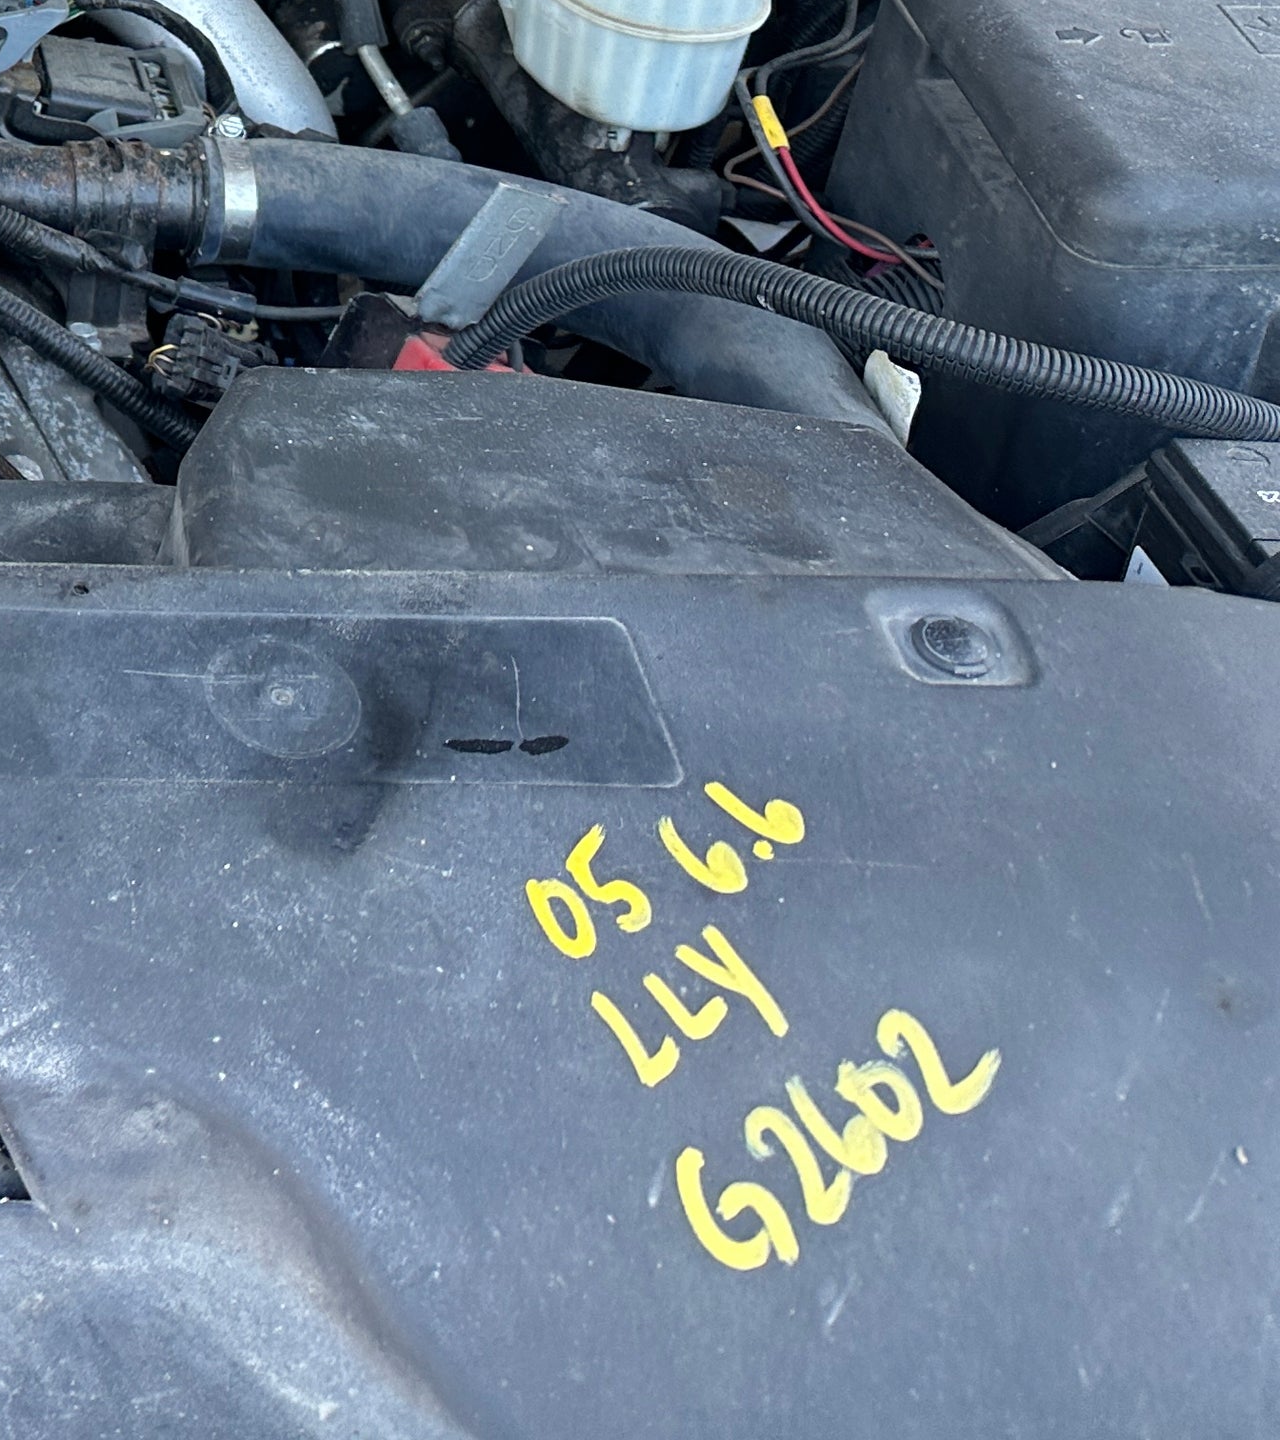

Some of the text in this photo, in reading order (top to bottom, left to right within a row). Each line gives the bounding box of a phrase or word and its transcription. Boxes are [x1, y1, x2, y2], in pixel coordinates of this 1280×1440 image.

[526, 781, 805, 959] 05 6.6
[591, 925, 788, 1087] LLY
[676, 1009, 1002, 1271] G2602
